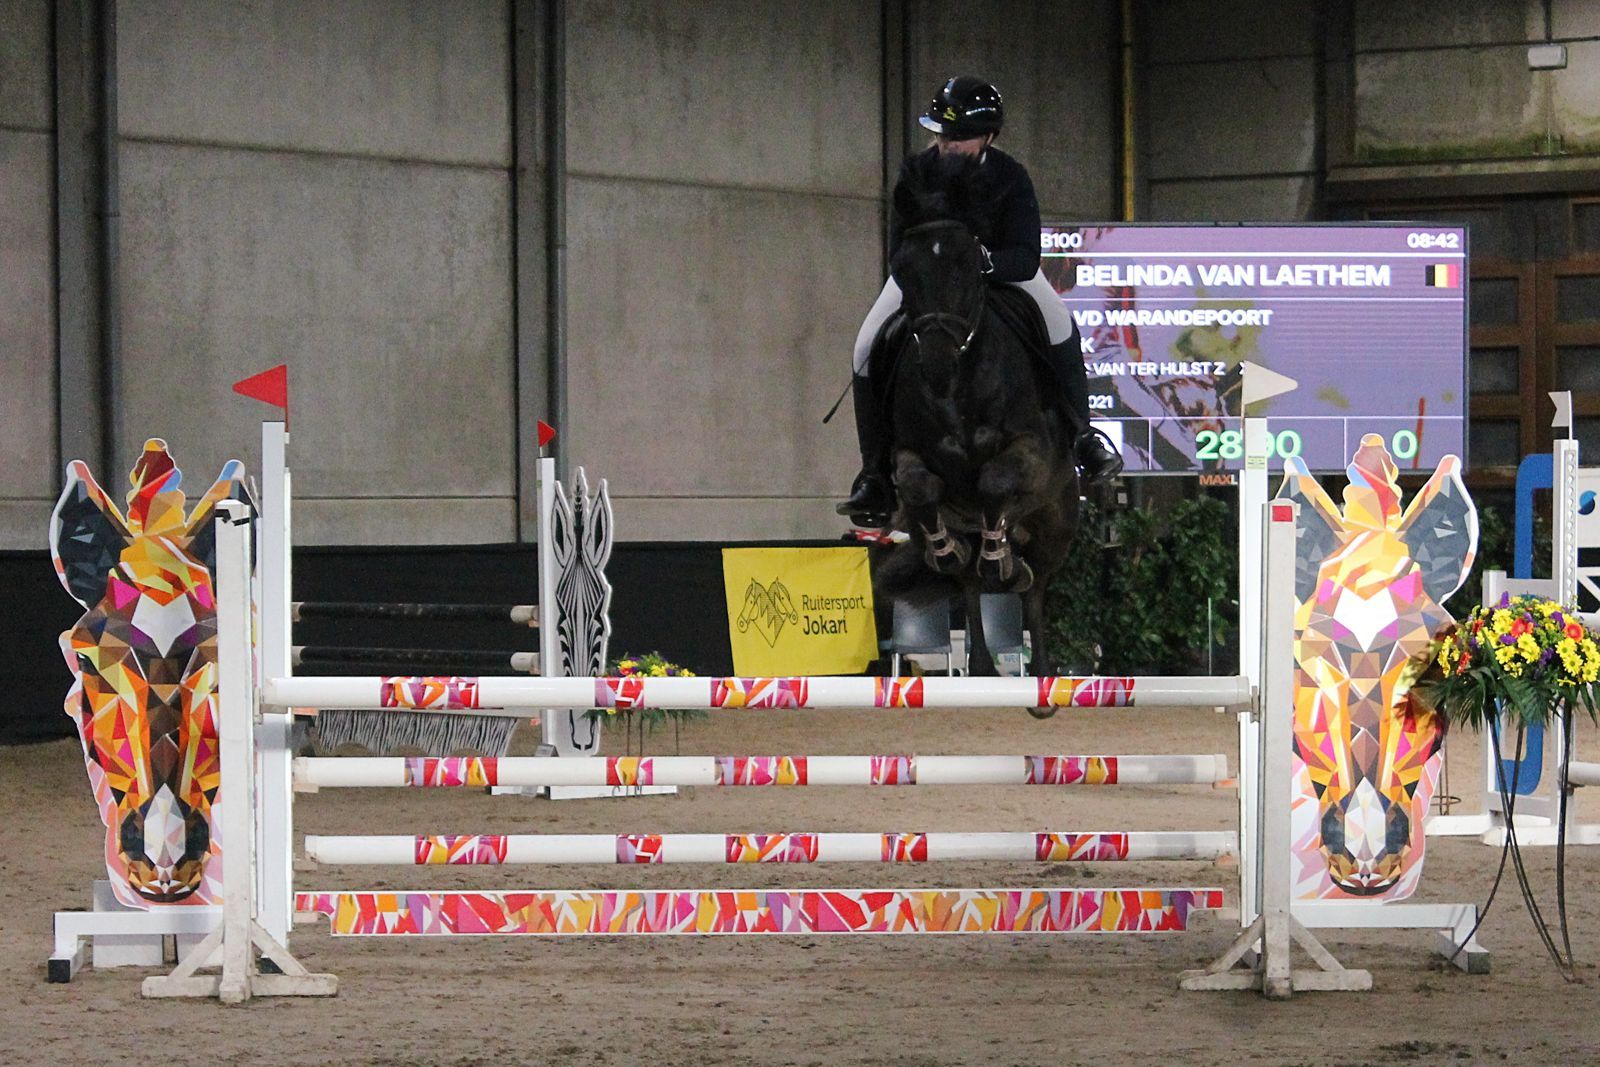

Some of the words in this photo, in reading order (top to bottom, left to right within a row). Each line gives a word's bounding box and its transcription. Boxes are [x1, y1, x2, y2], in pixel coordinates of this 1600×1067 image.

[1407, 232, 1459, 248] 08:42
[1076, 265, 1193, 286] BELINDA
[1197, 265, 1254, 286] VAN
[1259, 265, 1390, 286] LAETHEM
[1073, 310, 1103, 326] VD
[1105, 310, 1273, 326] WARANDEPOORT
[1093, 362, 1125, 376] VAN
[1127, 362, 1158, 376] TER
[1160, 362, 1209, 376] HULST
[1213, 362, 1226, 376] Z
[1088, 395, 1113, 409] 021
[1392, 430, 1418, 459] 0
[802, 595, 866, 613] Ruitersport
[803, 615, 848, 635] Jokari
